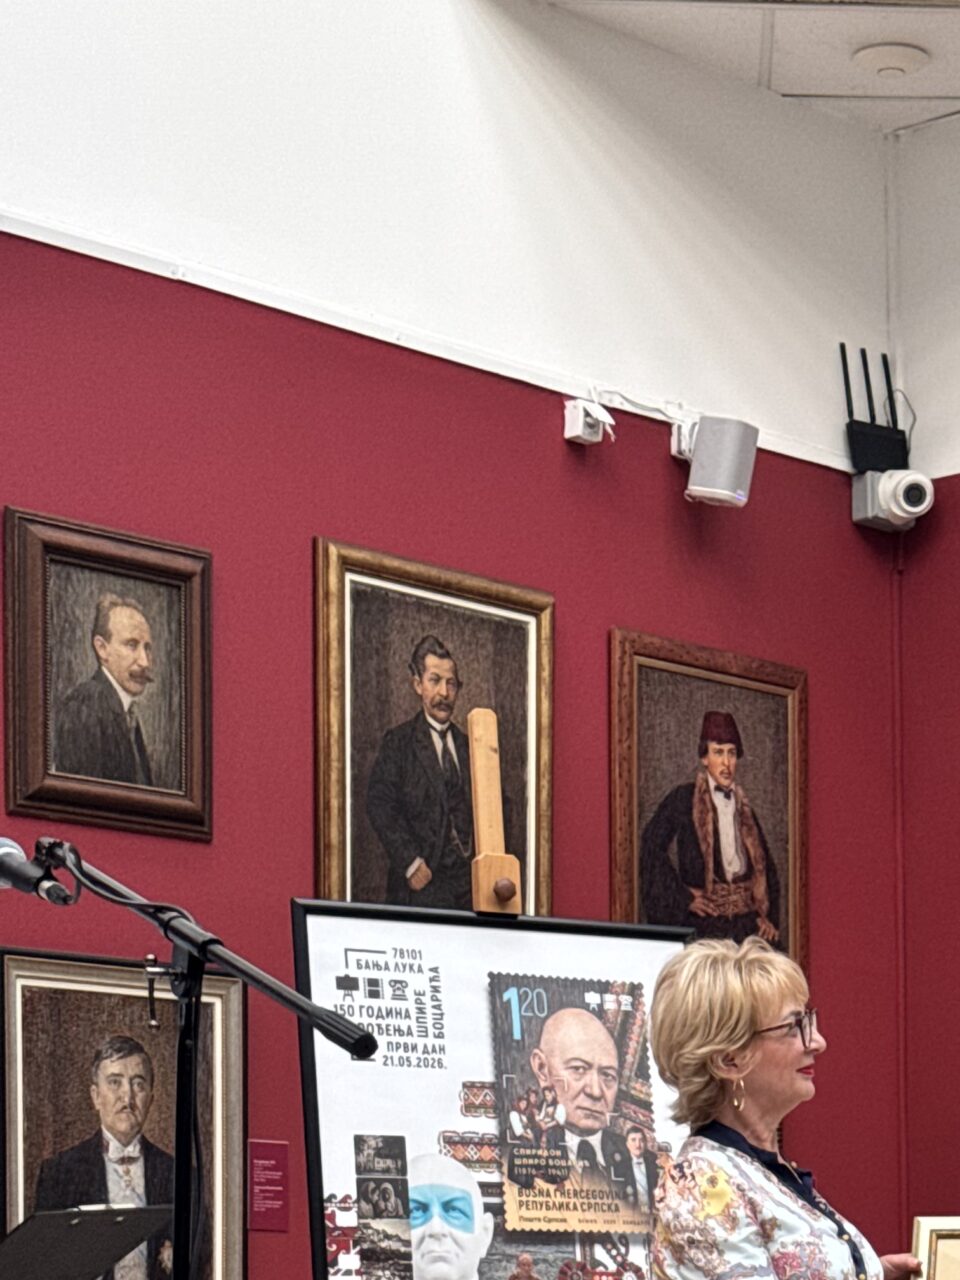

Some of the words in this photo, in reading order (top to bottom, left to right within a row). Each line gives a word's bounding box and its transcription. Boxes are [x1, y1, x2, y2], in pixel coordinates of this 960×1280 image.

[391, 947, 423, 961] 78101
[356, 958, 391, 972] БАЊА
[393, 961, 425, 975] ЛУКА
[428, 966, 446, 1039] БОЦАРИЋА
[333, 1003, 355, 1018] 150
[358, 1005, 412, 1021] ГОДИНА
[413, 989, 429, 1038] ШПИРЕ
[386, 1041, 419, 1054] ПРВИ
[421, 1043, 446, 1056] ДАН
[382, 1055, 448, 1070] 21.05.2026.
[517, 1187, 552, 1199] BOSNA
[559, 1188, 628, 1201] HERCEGOVIN
[518, 1199, 579, 1212] РЕПУБЛИКА
[580, 1201, 621, 1213] СРПСКА
